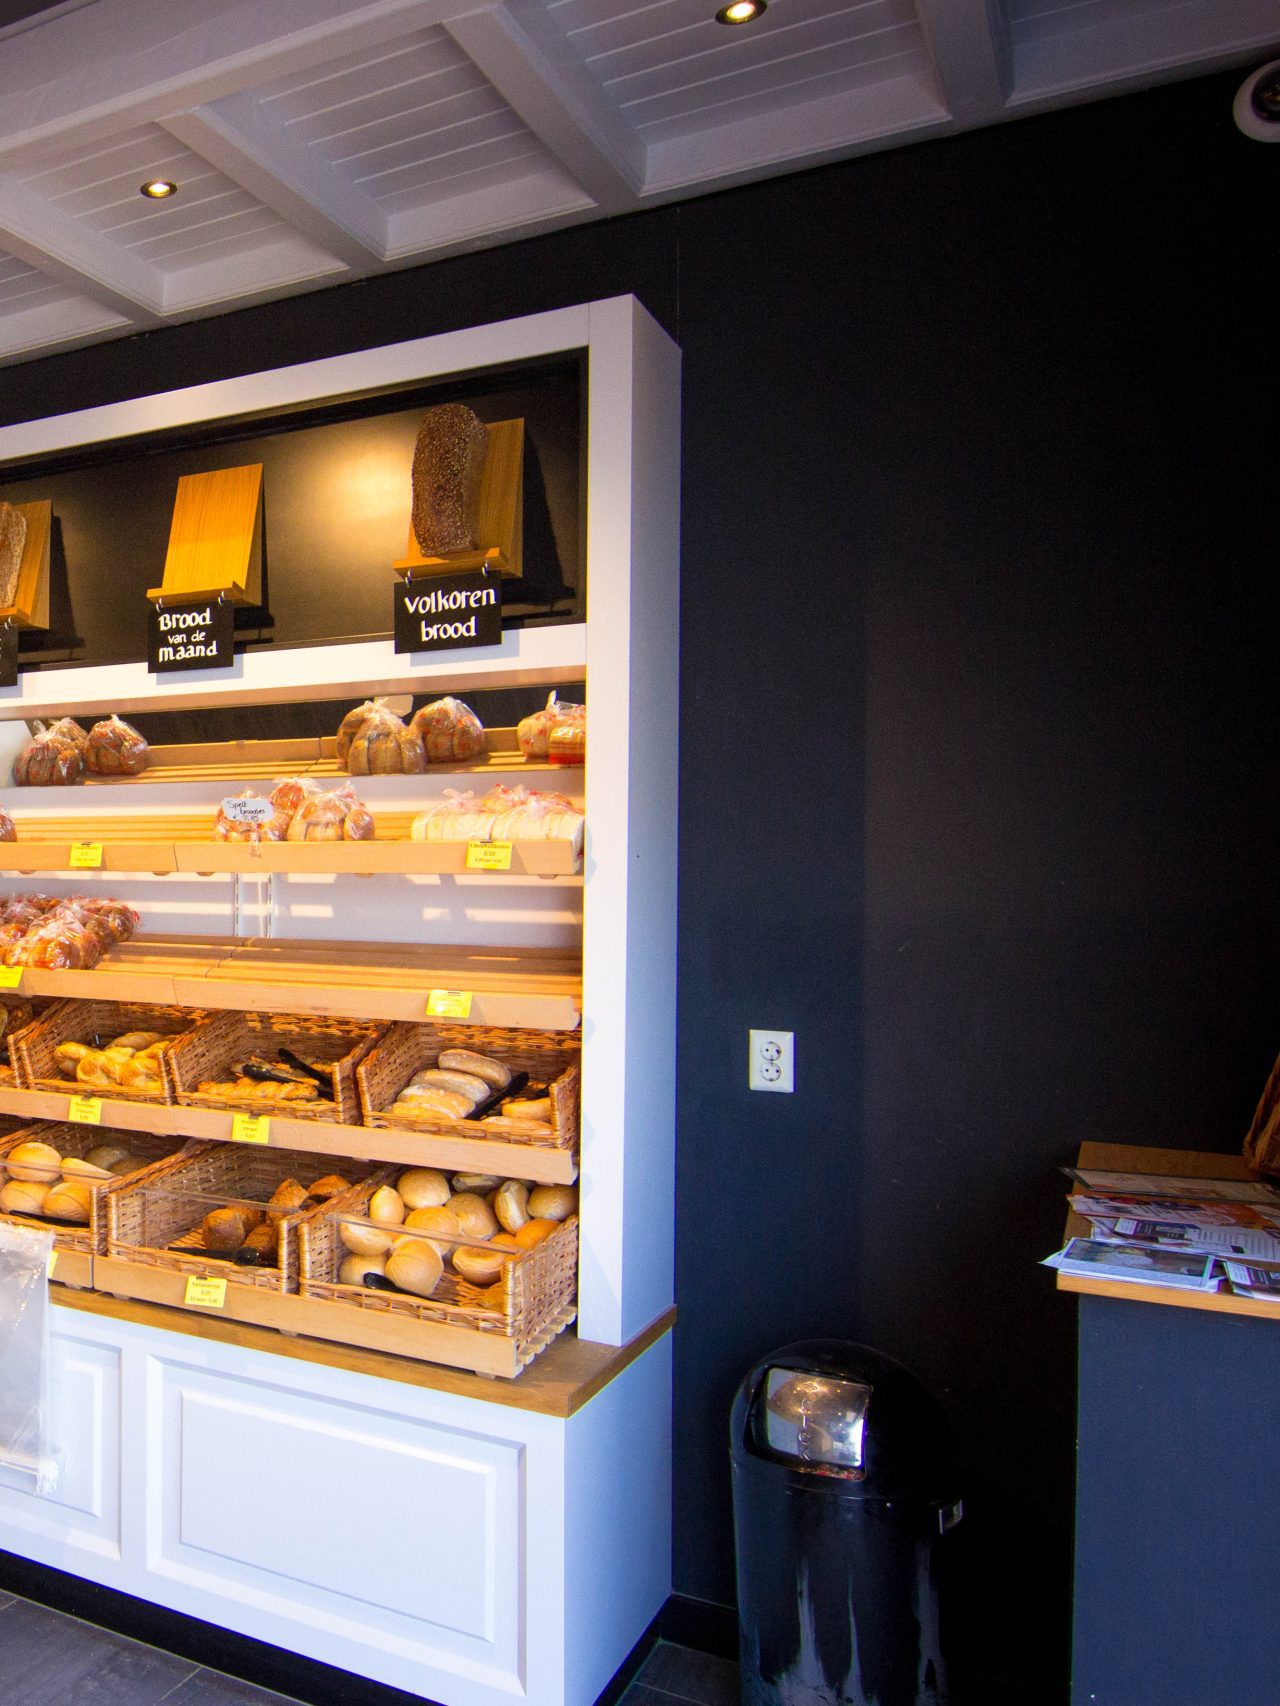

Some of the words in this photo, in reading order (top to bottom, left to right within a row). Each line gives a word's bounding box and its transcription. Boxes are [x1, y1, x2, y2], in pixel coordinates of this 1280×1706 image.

[158, 607, 213, 631] Brood
[421, 616, 478, 642] brood
[167, 632, 188, 645] van
[191, 630, 206, 642] de
[158, 641, 218, 663] maand
[226, 800, 247, 810] Spelt
